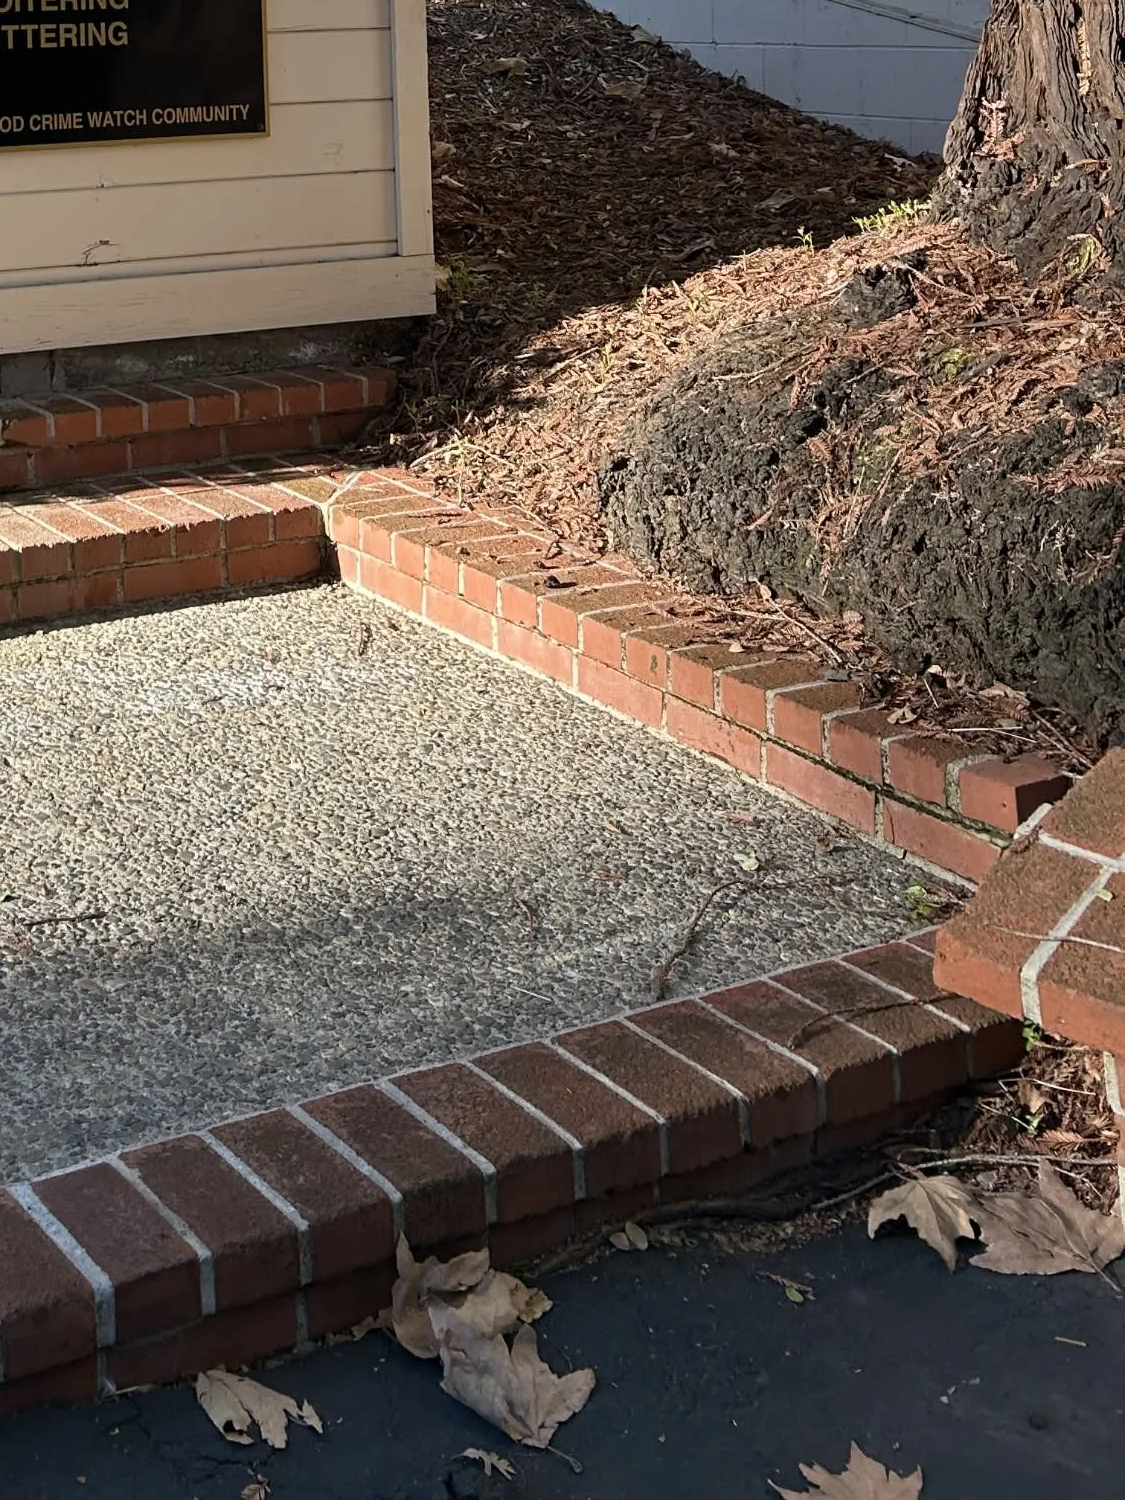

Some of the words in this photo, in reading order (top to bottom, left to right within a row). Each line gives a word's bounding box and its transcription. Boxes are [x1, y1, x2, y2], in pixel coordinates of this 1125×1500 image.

[29, 112, 84, 132] CRIME
[86, 108, 148, 128] WATCH
[151, 103, 250, 125] COMMUNITY
